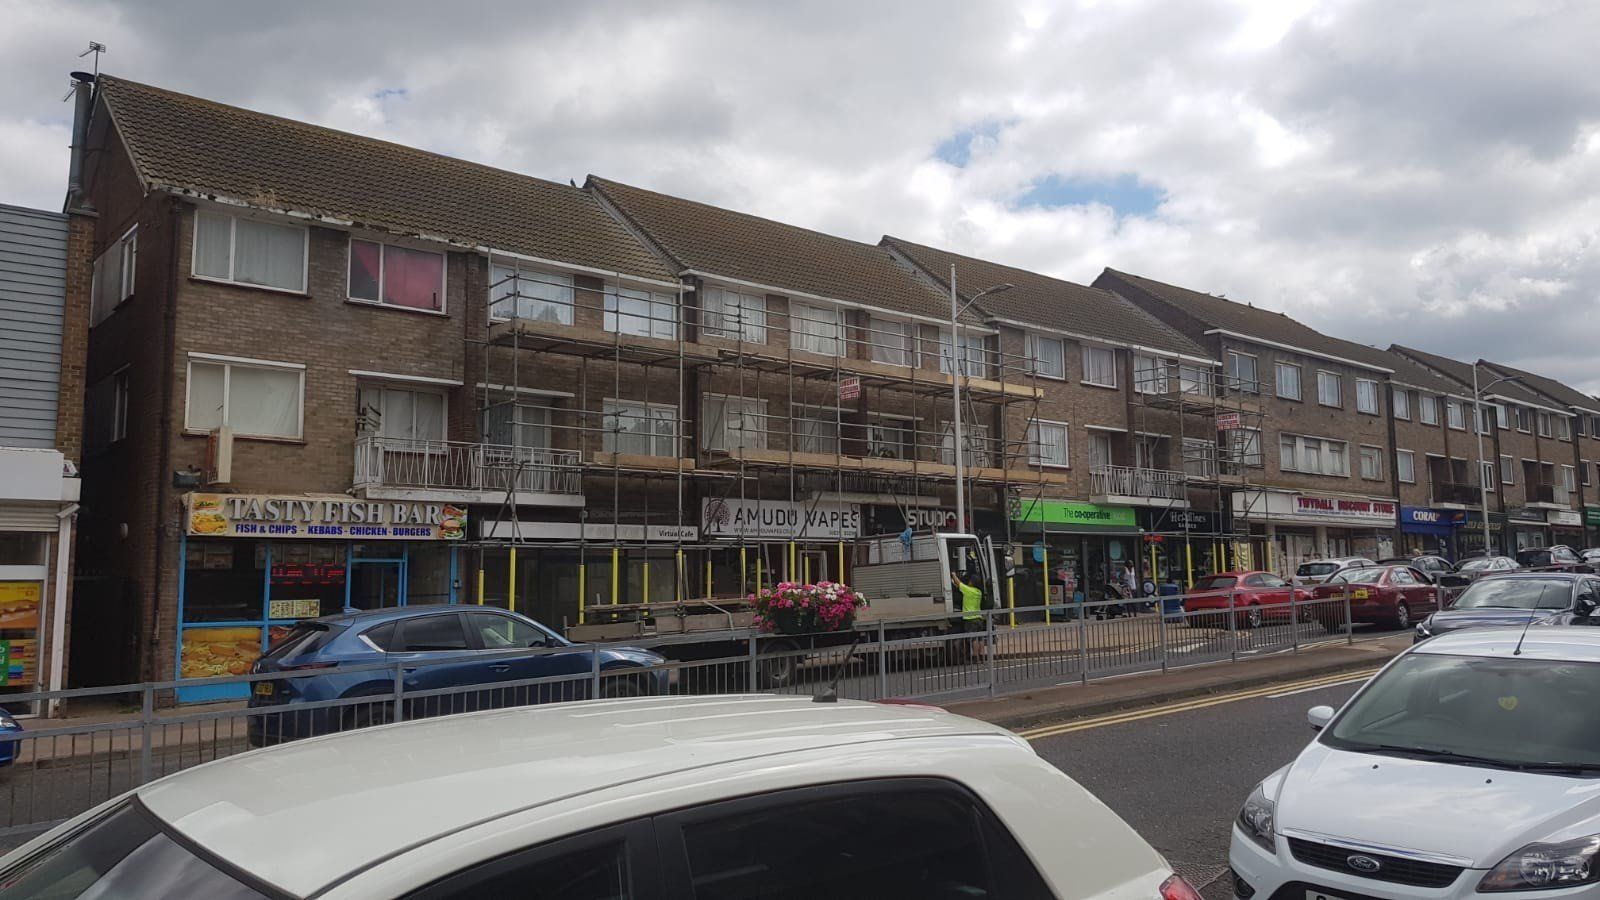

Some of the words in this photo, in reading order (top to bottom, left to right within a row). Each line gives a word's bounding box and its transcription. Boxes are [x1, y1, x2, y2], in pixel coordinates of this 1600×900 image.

[228, 498, 317, 523] TASTY
[321, 500, 386, 524] FISH
[390, 503, 442, 526] BAR
[1063, 507, 1074, 518] The
[1074, 510, 1111, 520] co-operative
[1338, 500, 1371, 513] DISCOUNT
[1373, 502, 1394, 514] STORE
[734, 507, 797, 526] AMUDU
[806, 510, 860, 528] VAPES
[1413, 510, 1437, 522] CORAL
[235, 524, 259, 534] FISH
[260, 526, 266, 534] &
[268, 525, 297, 535] CHIPS
[308, 525, 343, 536] KEBABS
[349, 526, 388, 536] CHICKEN
[392, 527, 431, 537] BURGERS
[659, 529, 680, 537] Virtual
